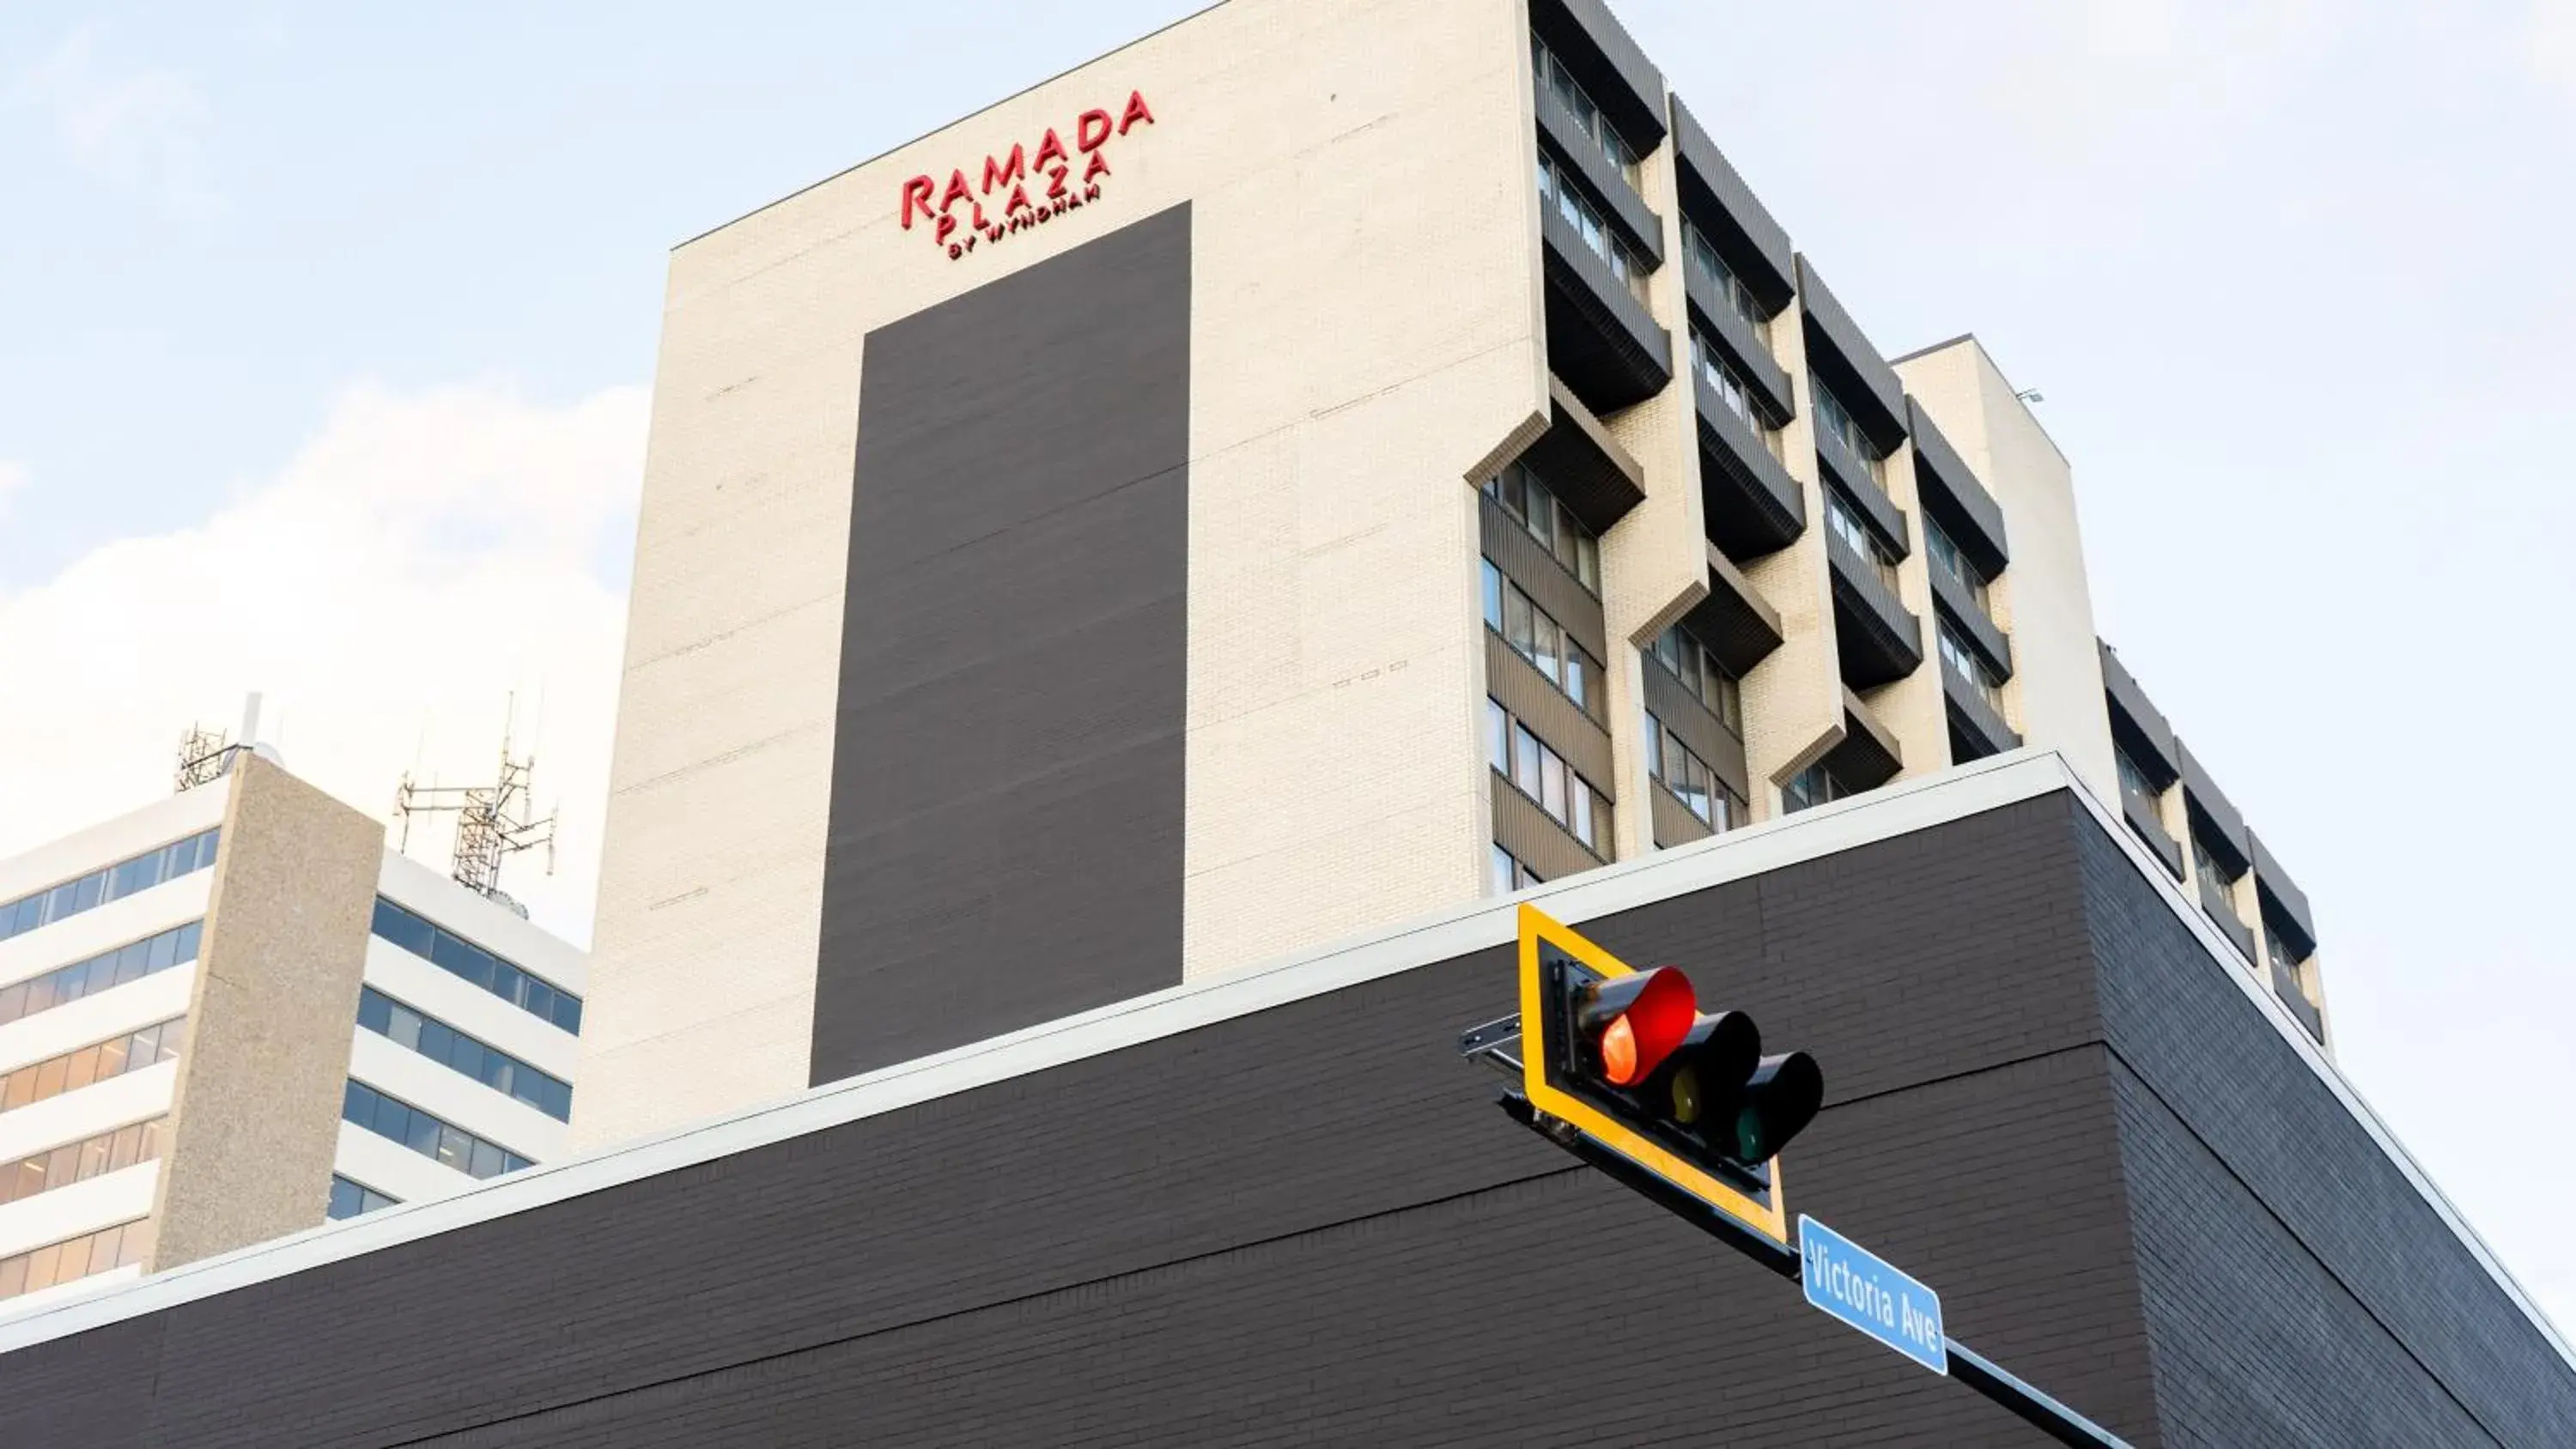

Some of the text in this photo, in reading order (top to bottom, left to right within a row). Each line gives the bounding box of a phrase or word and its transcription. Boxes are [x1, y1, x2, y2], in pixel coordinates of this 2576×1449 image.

[902, 89, 1154, 230] RAMADA
[935, 149, 1111, 246] PLAZA
[948, 183, 1101, 260] BY WYNDHAM
[1808, 1239, 1938, 1353] Victoria Ave
